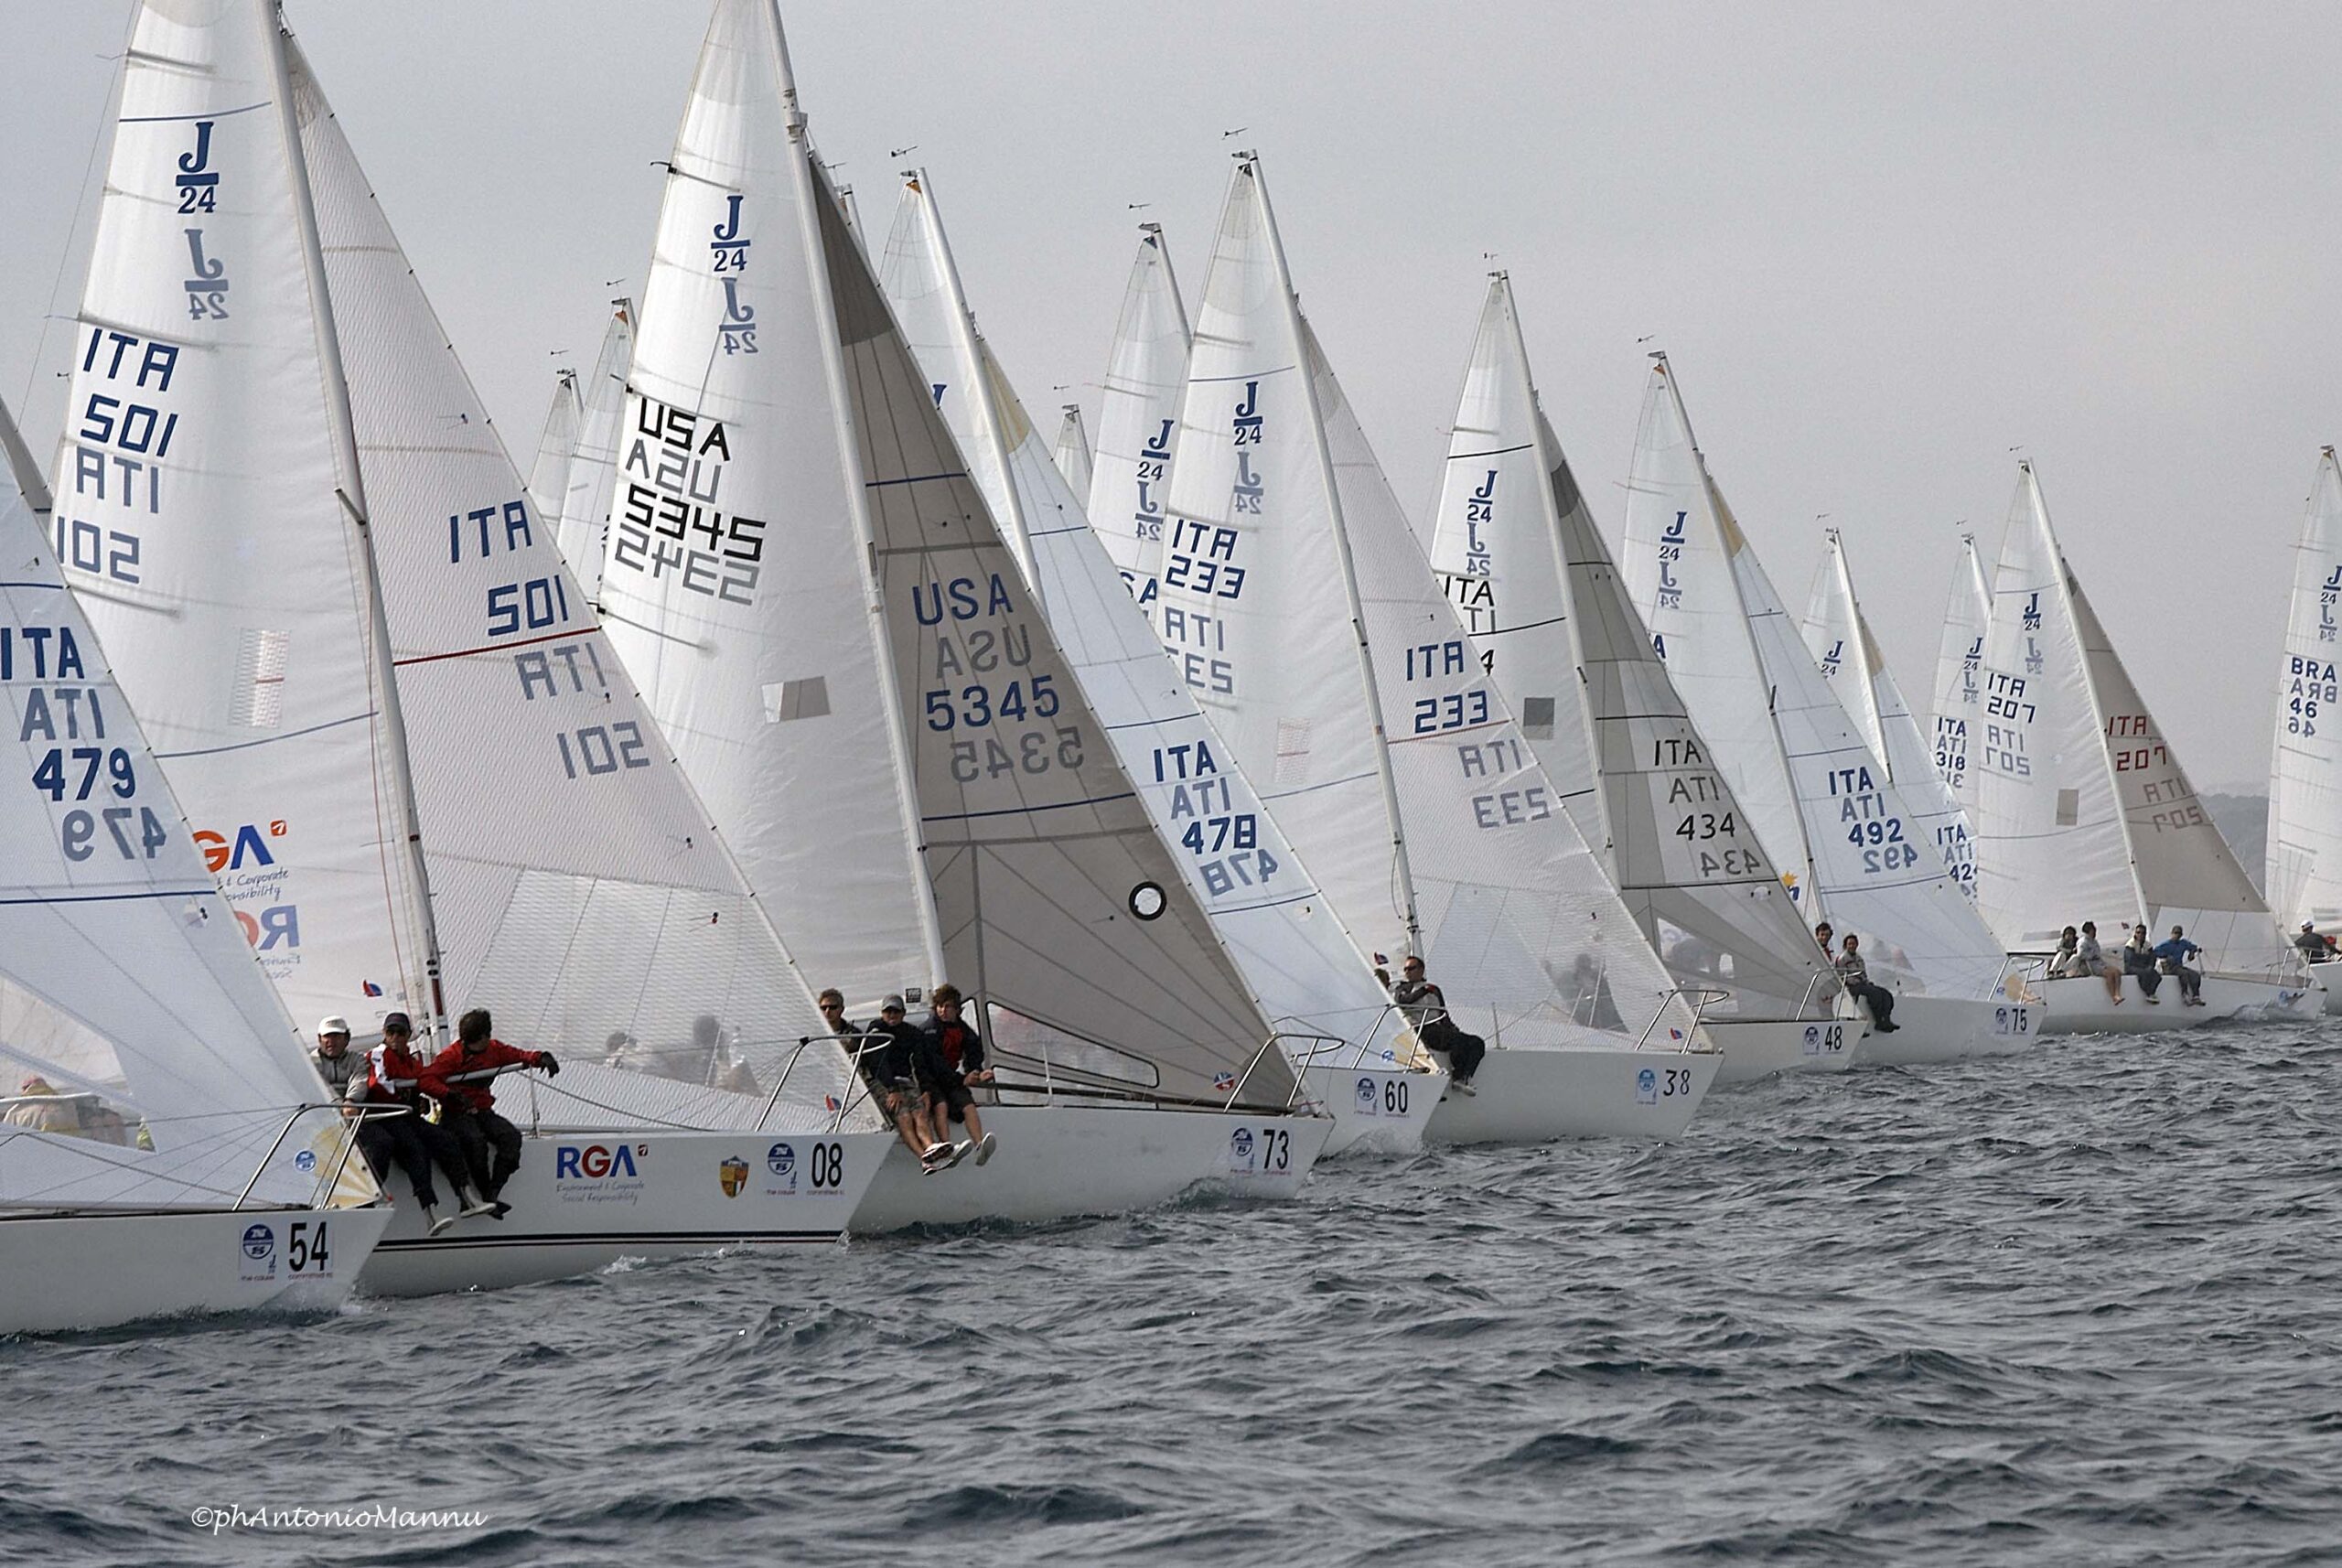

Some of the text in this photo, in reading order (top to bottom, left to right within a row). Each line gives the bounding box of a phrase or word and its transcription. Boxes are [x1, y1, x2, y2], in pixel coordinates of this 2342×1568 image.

[178, 121, 215, 174] J
[178, 187, 217, 214] 24
[713, 195, 745, 241] J
[713, 248, 747, 273] 24
[83, 328, 179, 392] ITA
[1235, 381, 1259, 417] J
[80, 393, 178, 457] 501
[638, 396, 731, 462] USA
[1148, 419, 1175, 450] J
[1234, 424, 1262, 446] 24
[1137, 461, 1164, 481] 24
[1475, 469, 1499, 499] J
[625, 483, 767, 563] 5345
[1466, 504, 1493, 523] 24
[1666, 510, 1688, 537] J
[449, 499, 532, 564] ITA
[1172, 519, 1239, 561] ITA
[1659, 545, 1681, 562] 24
[1166, 554, 1246, 600] 233
[1445, 575, 1495, 607] ITA
[488, 575, 569, 637] 501
[911, 573, 1014, 627] USA
[2025, 593, 2040, 614] J
[2320, 592, 2337, 605] 24
[2025, 619, 2041, 631] 24
[0, 627, 85, 680] ITA
[1828, 640, 1843, 658] J
[1969, 637, 1983, 654] J
[1406, 640, 1465, 682] ITA
[1821, 663, 1837, 676] 24
[1963, 660, 1978, 671] 24
[2291, 656, 2337, 683] BRA
[1988, 672, 2026, 698] ITA
[925, 674, 1059, 733] 5345
[1414, 690, 1489, 734] 233
[1987, 695, 2036, 724] 207
[2290, 697, 2317, 719] 46
[1937, 716, 1967, 737] ITA
[2108, 715, 2147, 736] ITA
[1153, 740, 1218, 783] ITA
[1654, 739, 1703, 767] ITA
[1936, 751, 1966, 771] 318
[2116, 746, 2167, 772] 207
[32, 747, 135, 801] 479
[1829, 767, 1875, 795] ITA
[1181, 814, 1257, 855] 478
[1675, 811, 1735, 842] 434
[1847, 818, 1904, 847] 492
[1937, 824, 1967, 845] ITA
[192, 824, 274, 873] GA
[236, 866, 289, 888] Corporate
[1949, 863, 1978, 883] 42
[225, 884, 282, 902] onsibility
[2012, 1008, 2027, 1032] 75
[1825, 1026, 1842, 1051] 48
[1384, 1079, 1408, 1113] 60
[1663, 1069, 1691, 1097] 38
[556, 1144, 637, 1179] RGA
[1262, 1129, 1290, 1170] 73
[811, 1142, 843, 1187] 08
[289, 1221, 329, 1273] 54
